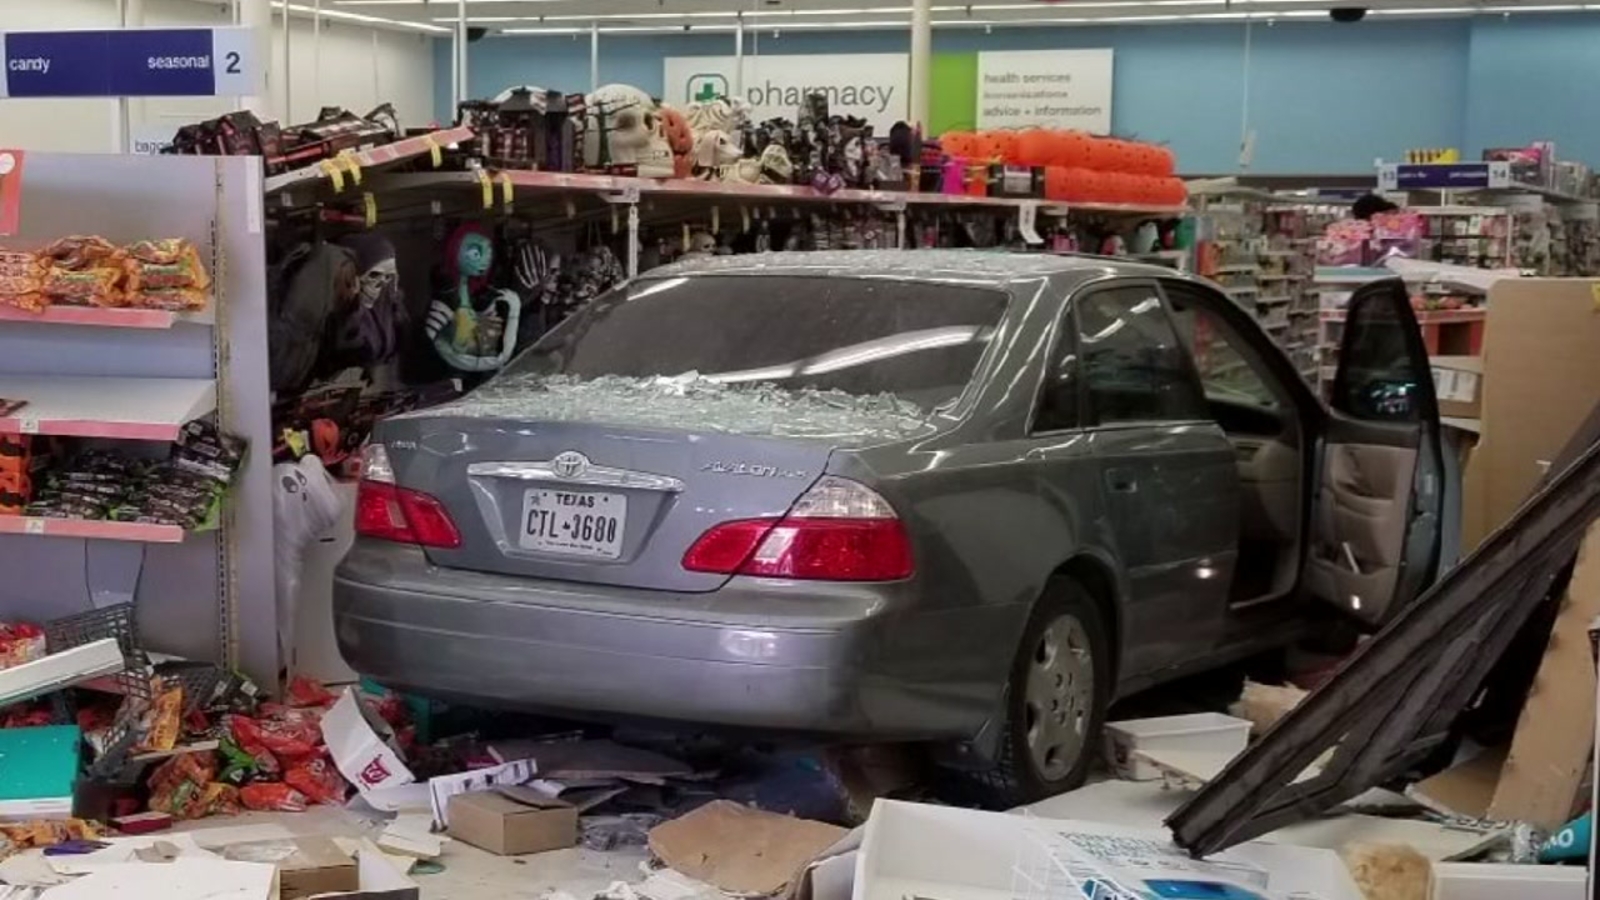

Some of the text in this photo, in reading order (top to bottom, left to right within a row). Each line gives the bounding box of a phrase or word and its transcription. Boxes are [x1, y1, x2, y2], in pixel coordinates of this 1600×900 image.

[9, 55, 51, 74] candy
[147, 54, 210, 69] seasonal
[225, 52, 241, 73] 2
[984, 73, 1071, 84] health services
[747, 80, 895, 113] pharmacy
[983, 105, 1021, 117] advice
[1034, 105, 1102, 117] information
[555, 493, 595, 508] TEXAS
